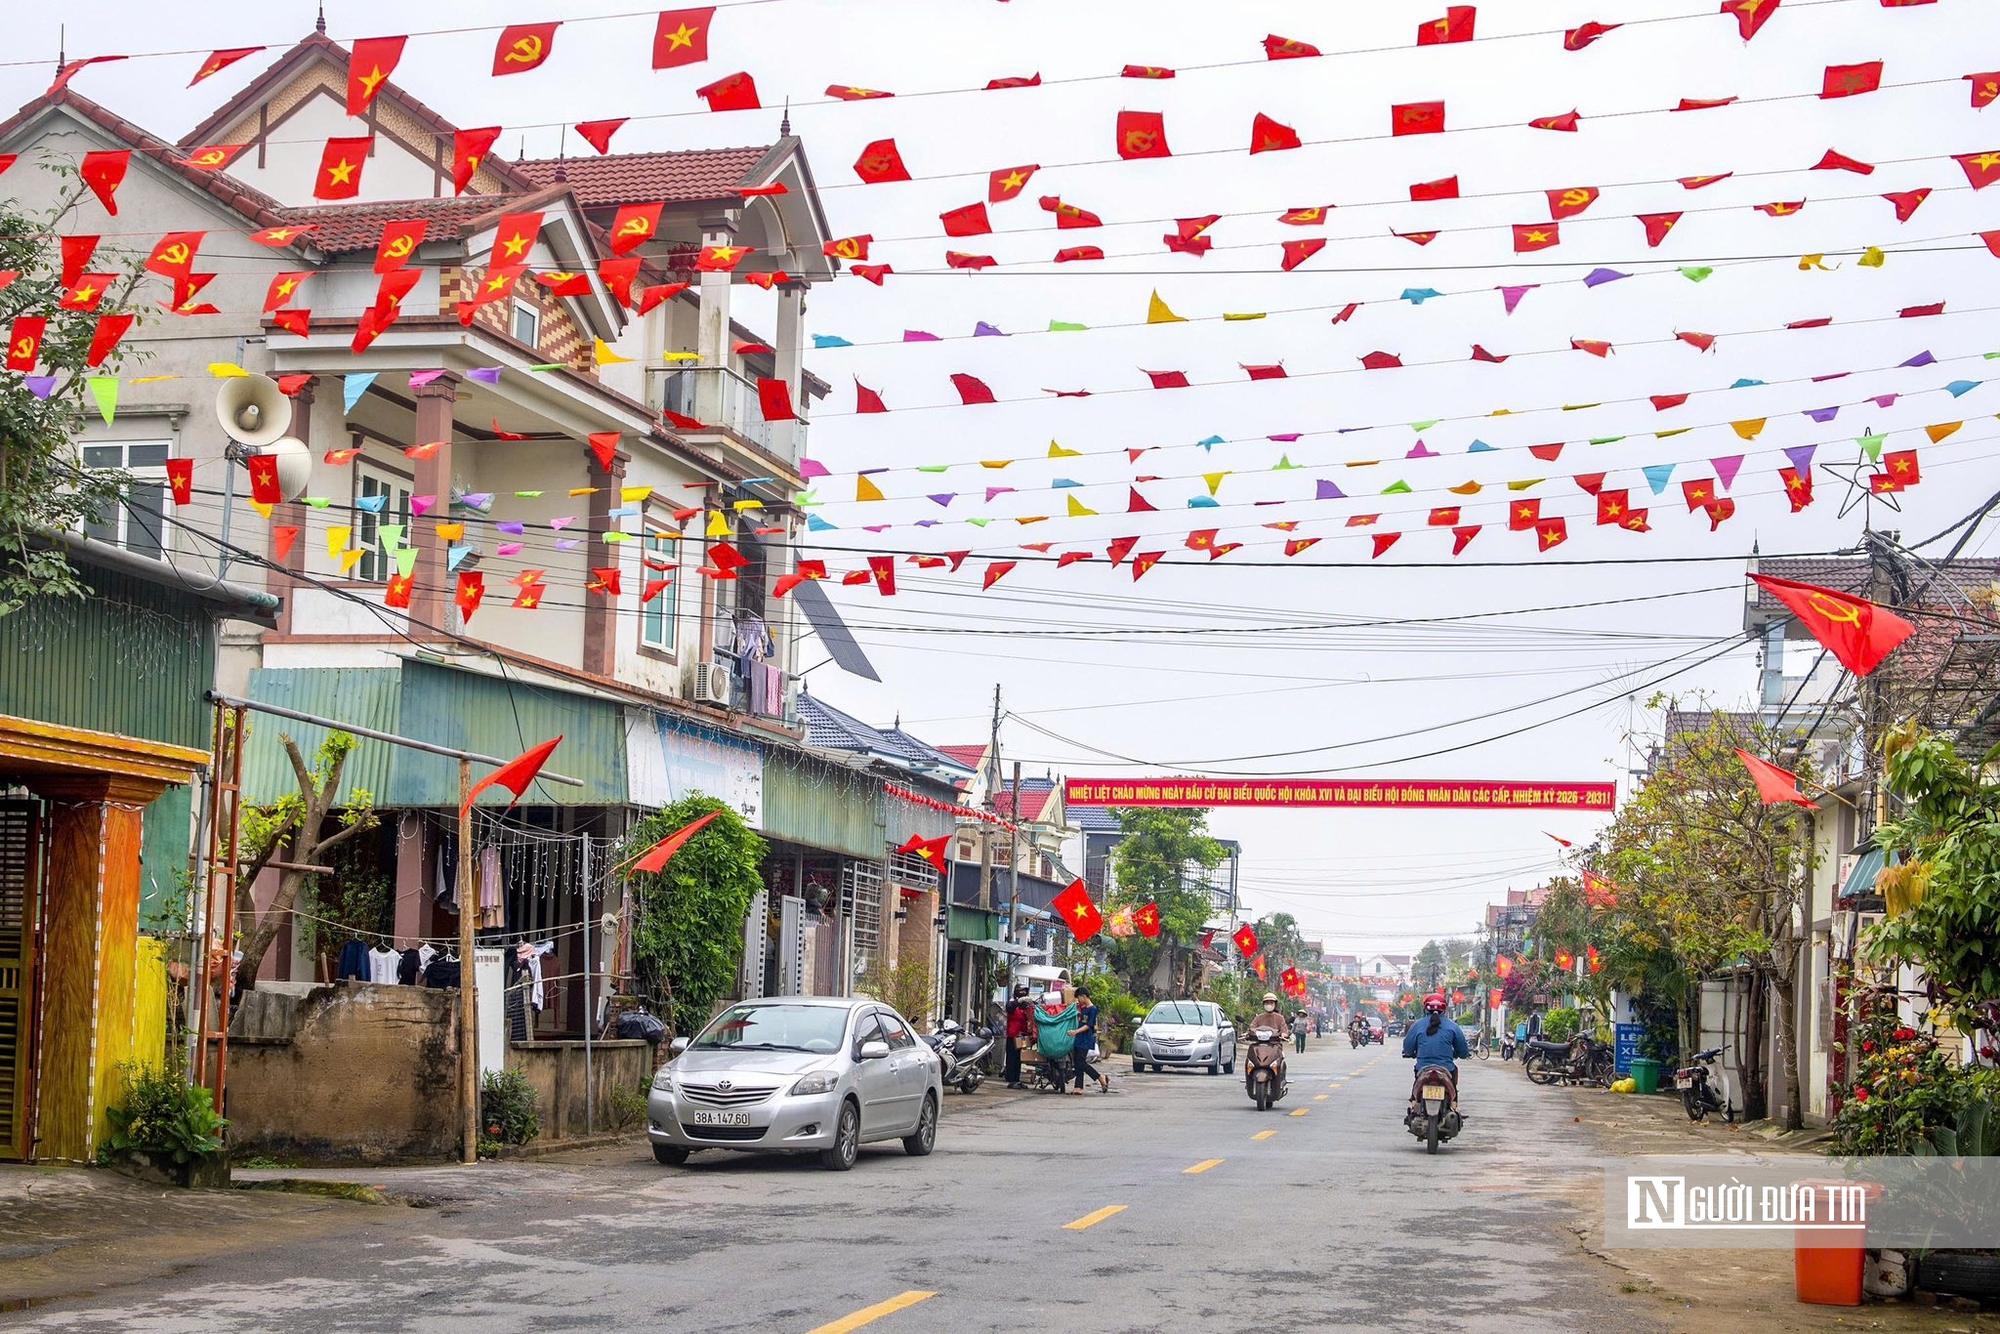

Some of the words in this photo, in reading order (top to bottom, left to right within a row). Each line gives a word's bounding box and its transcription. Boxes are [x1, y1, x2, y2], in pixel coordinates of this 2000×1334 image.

[1069, 784, 1093, 802] NHIỆT
[1094, 784, 1111, 802] LIỆT
[1112, 784, 1134, 800] CHÀO
[1136, 785, 1160, 800] MỪNG
[1162, 785, 1184, 800] NGÀY
[1204, 783, 1216, 800] CỬ
[1217, 787, 1231, 803] ĐẠI
[1234, 783, 1252, 800] BIỂU
[1255, 783, 1276, 801] QUỐC
[1278, 785, 1292, 803] HỘI
[1295, 785, 1317, 801] KHÓA
[1319, 788, 1333, 801] XVI
[1334, 785, 1345, 801] VÀ
[1347, 788, 1361, 804] ĐẠI
[1363, 784, 1383, 801] BIỂU
[1385, 786, 1399, 804] HỘI
[1426, 786, 1450, 802] NHÂN
[1453, 786, 1471, 802] DÂN
[1473, 786, 1490, 802] CÁC
[1513, 787, 1541, 805] NHIỆM
[1543, 788, 1555, 803] KỲ
[1556, 791, 1578, 804] 2026
